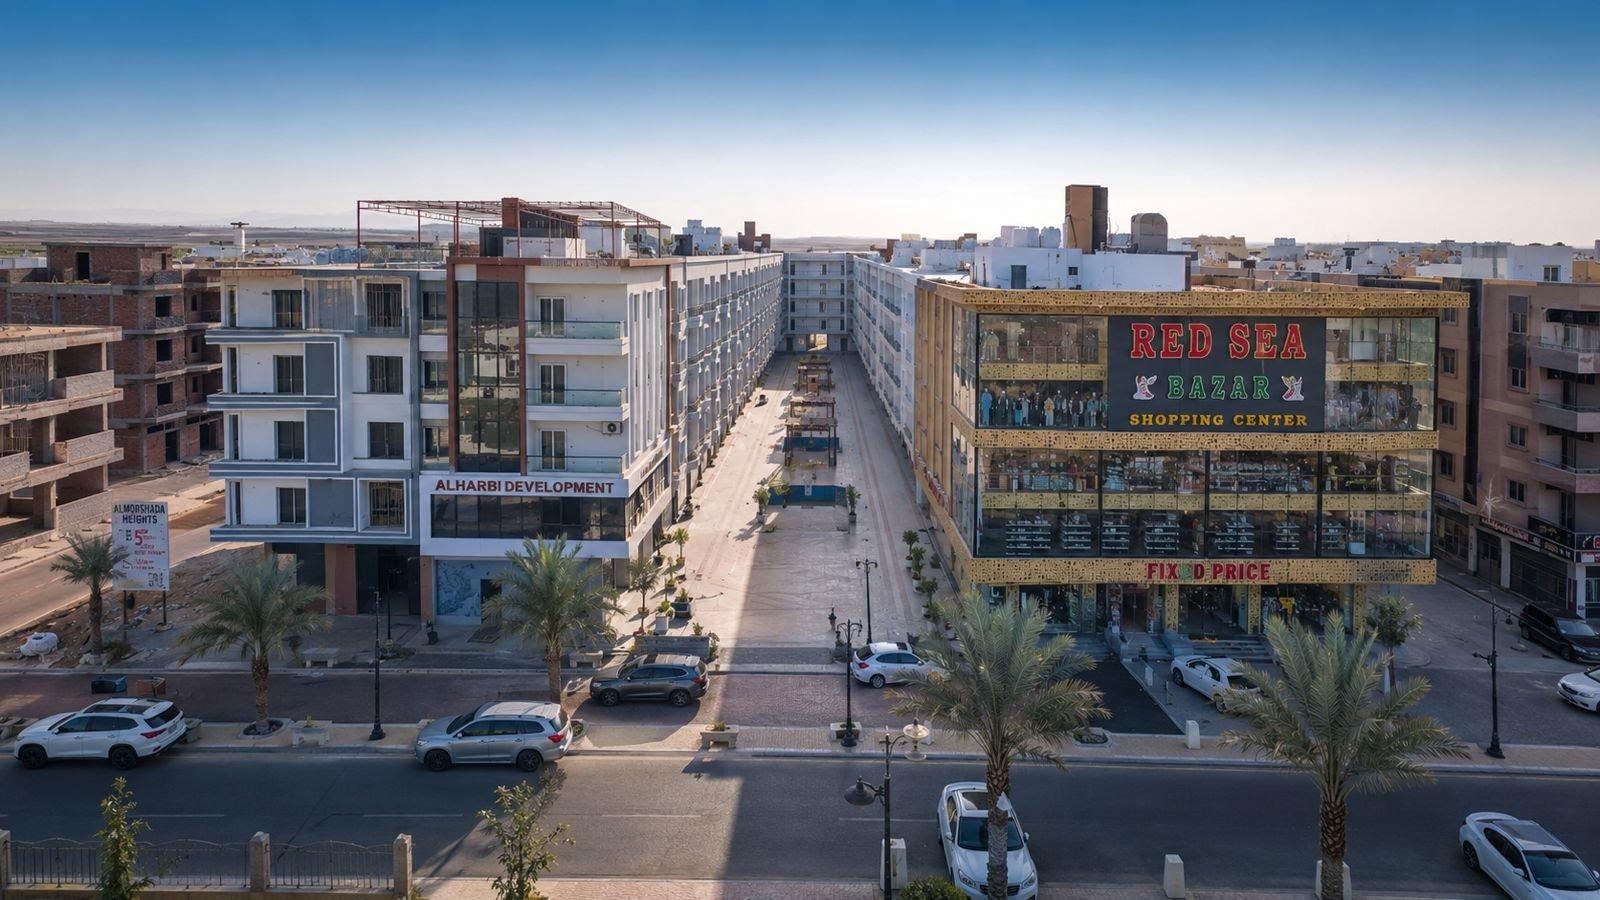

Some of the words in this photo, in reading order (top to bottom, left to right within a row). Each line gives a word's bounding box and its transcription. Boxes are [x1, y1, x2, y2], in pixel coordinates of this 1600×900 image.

[1130, 323, 1213, 359] RED
[1229, 323, 1307, 359] SEA
[1167, 375, 1270, 400] BAZAR
[1129, 413, 1224, 426] SHOPPING
[1233, 413, 1308, 426] CENTER
[435, 479, 501, 492] ALHARBI
[505, 481, 615, 494] DEVELOPMENT
[122, 515, 158, 524] HEIGHTS
[1212, 563, 1271, 580] PRICE
